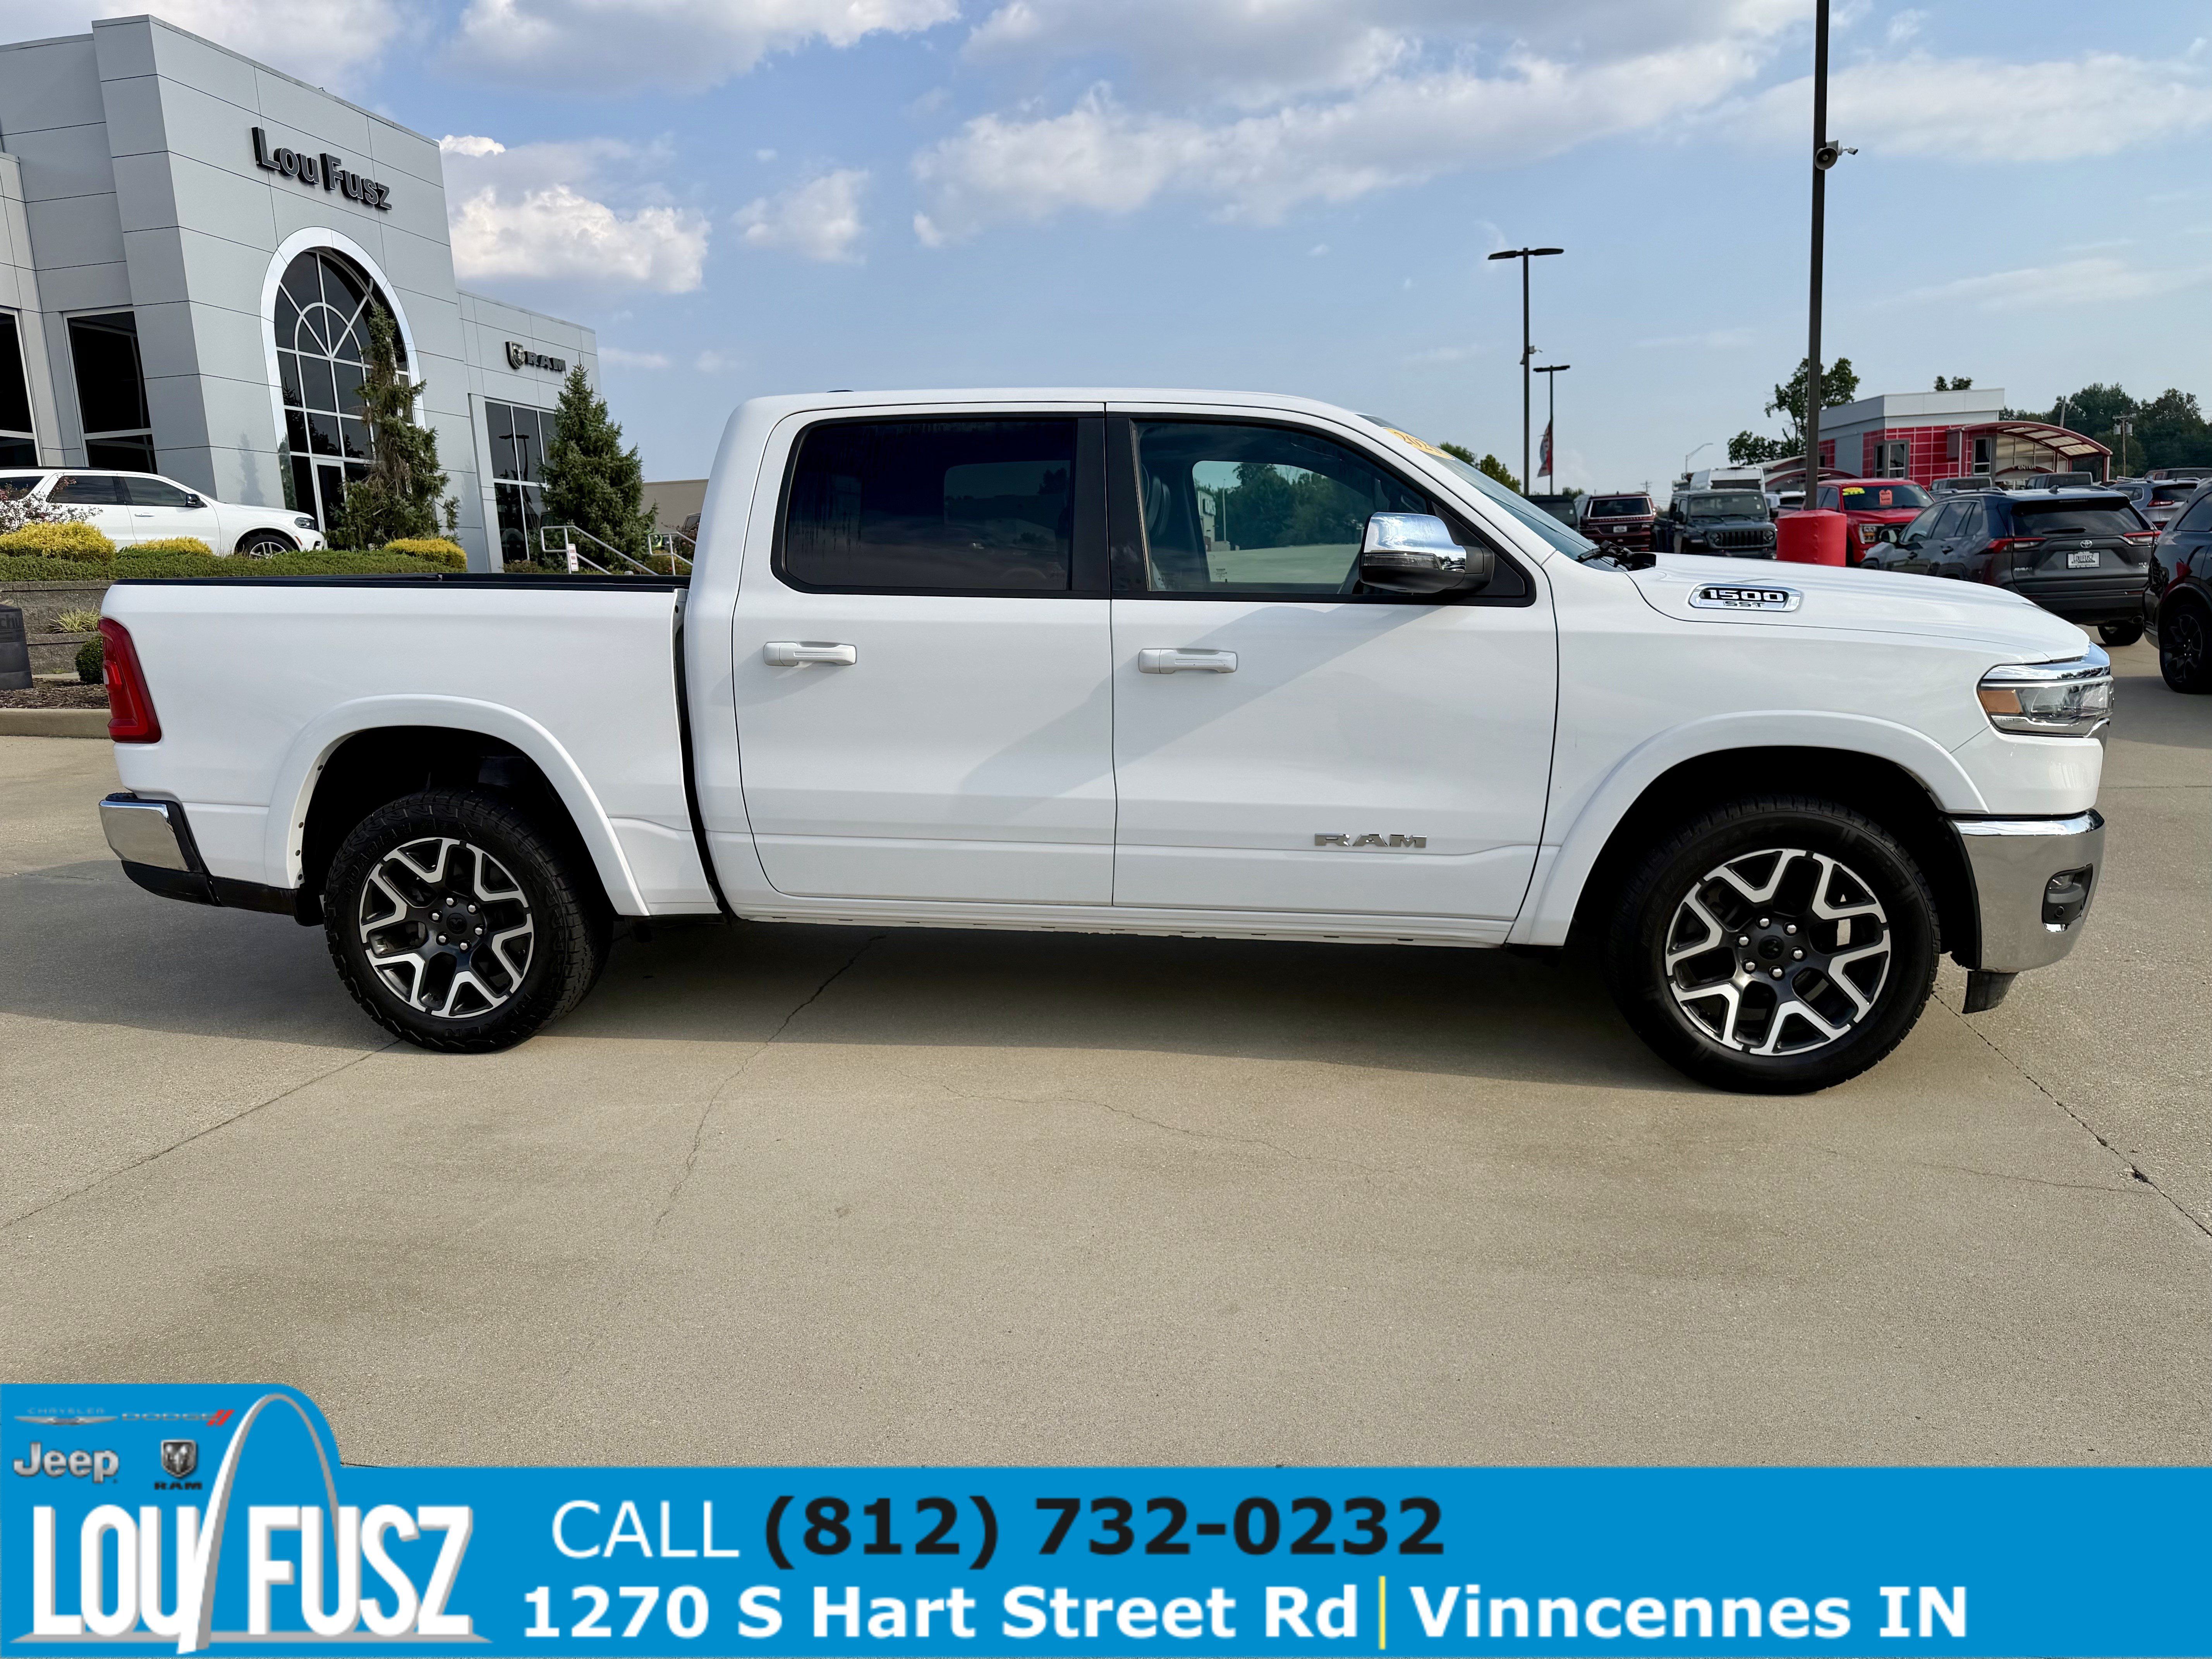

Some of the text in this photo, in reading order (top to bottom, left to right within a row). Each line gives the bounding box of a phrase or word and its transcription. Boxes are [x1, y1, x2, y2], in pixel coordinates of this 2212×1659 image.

[252, 127, 392, 210] Lou Fusz
[524, 351, 566, 372] RAM
[1708, 589, 1784, 601] 1500
[1315, 833, 1427, 848] RAM
